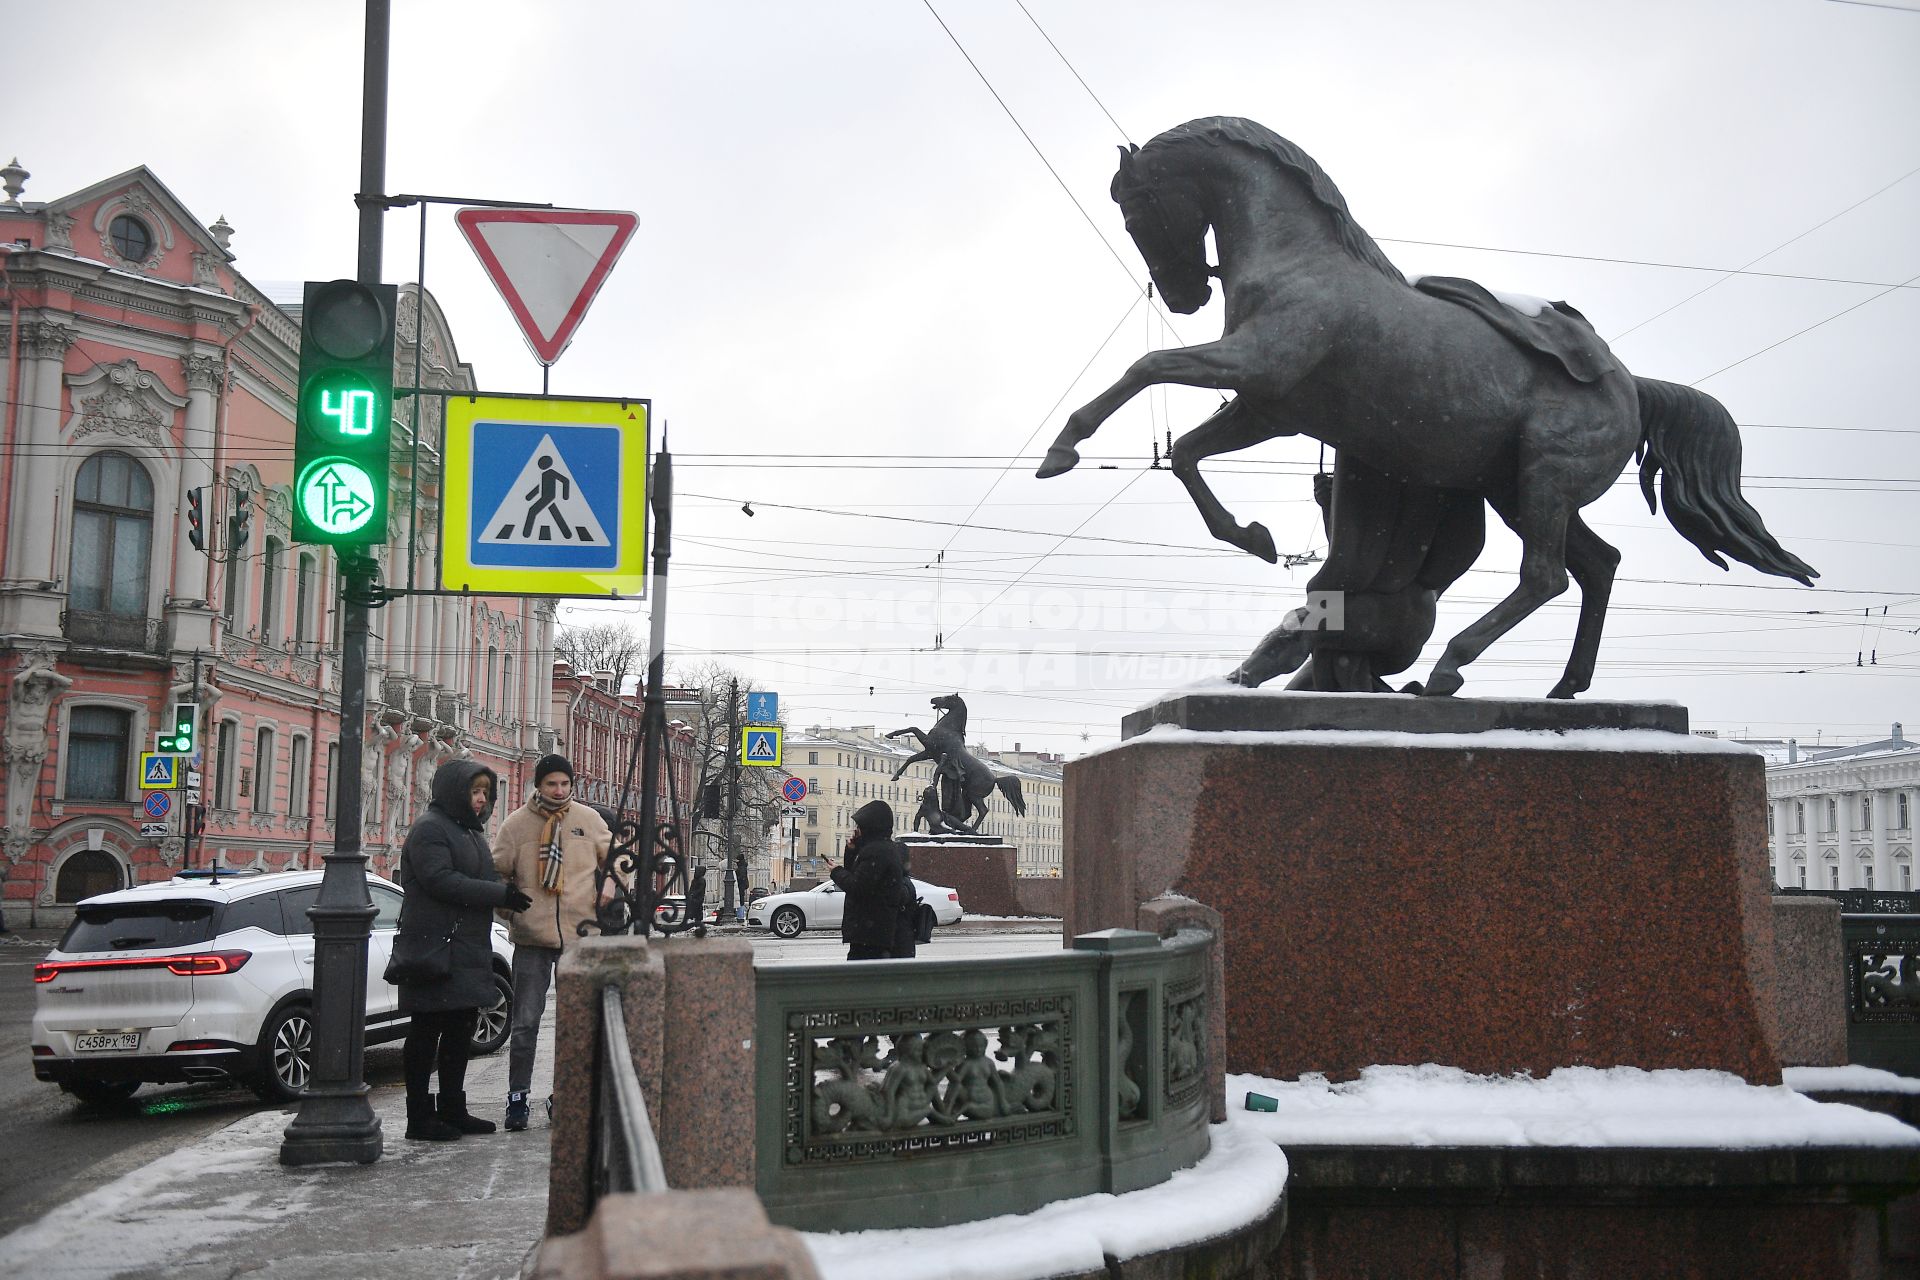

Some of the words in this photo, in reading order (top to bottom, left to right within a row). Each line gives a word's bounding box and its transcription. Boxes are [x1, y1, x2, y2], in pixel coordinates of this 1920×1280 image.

[321, 390, 374, 435] 40
[179, 724, 190, 734] 40
[120, 1034, 137, 1044] 198
